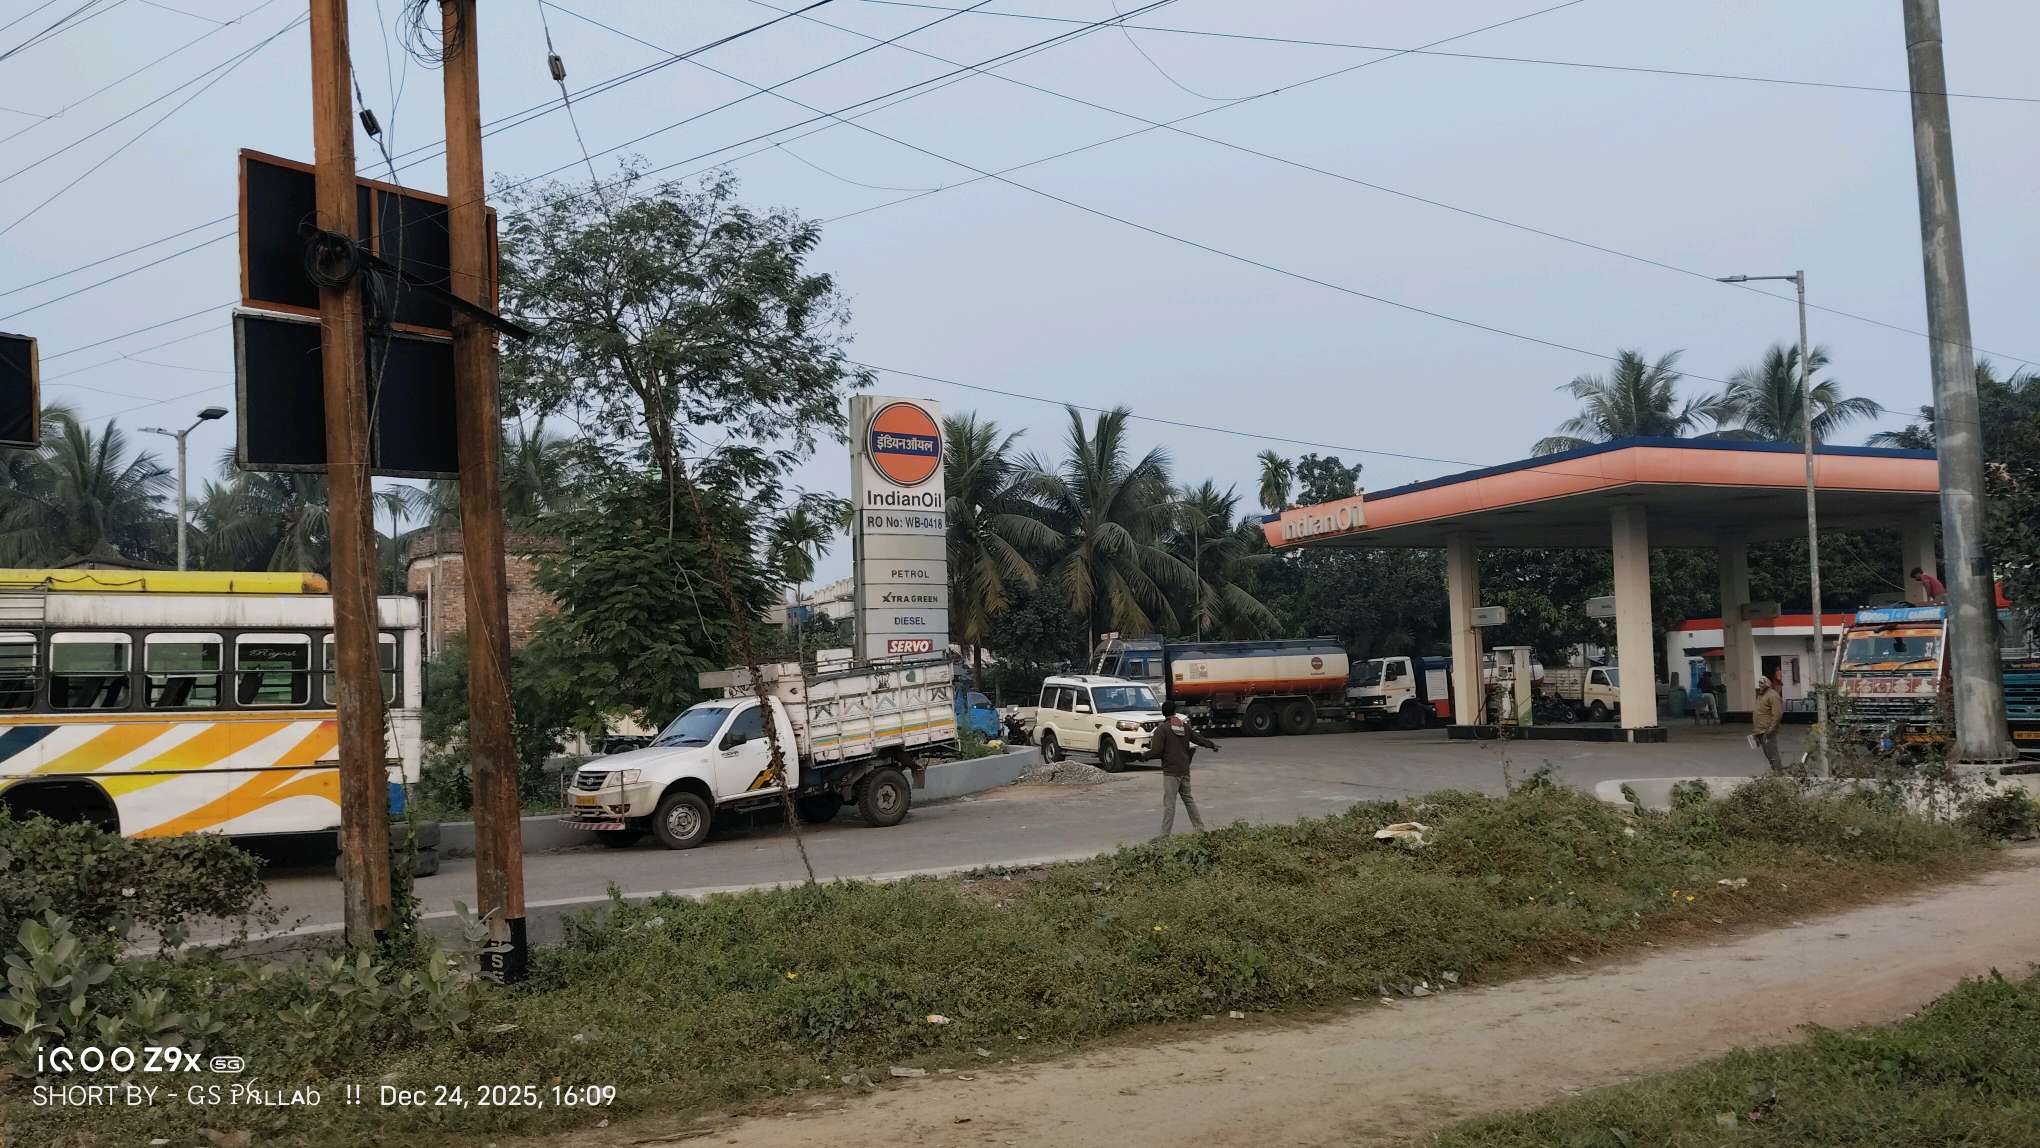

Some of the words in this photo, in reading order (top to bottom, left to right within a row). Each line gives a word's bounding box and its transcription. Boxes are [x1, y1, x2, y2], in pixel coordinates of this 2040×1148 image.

[877, 433, 934, 453] इंडियनऑयल
[867, 490, 942, 508] IndianOil
[867, 516, 883, 528] RO
[886, 516, 903, 528] No:
[905, 516, 943, 530] WB-0418
[891, 569, 930, 579] PETROL
[894, 616, 926, 625] DIESEL
[889, 640, 930, 653] SERVO
